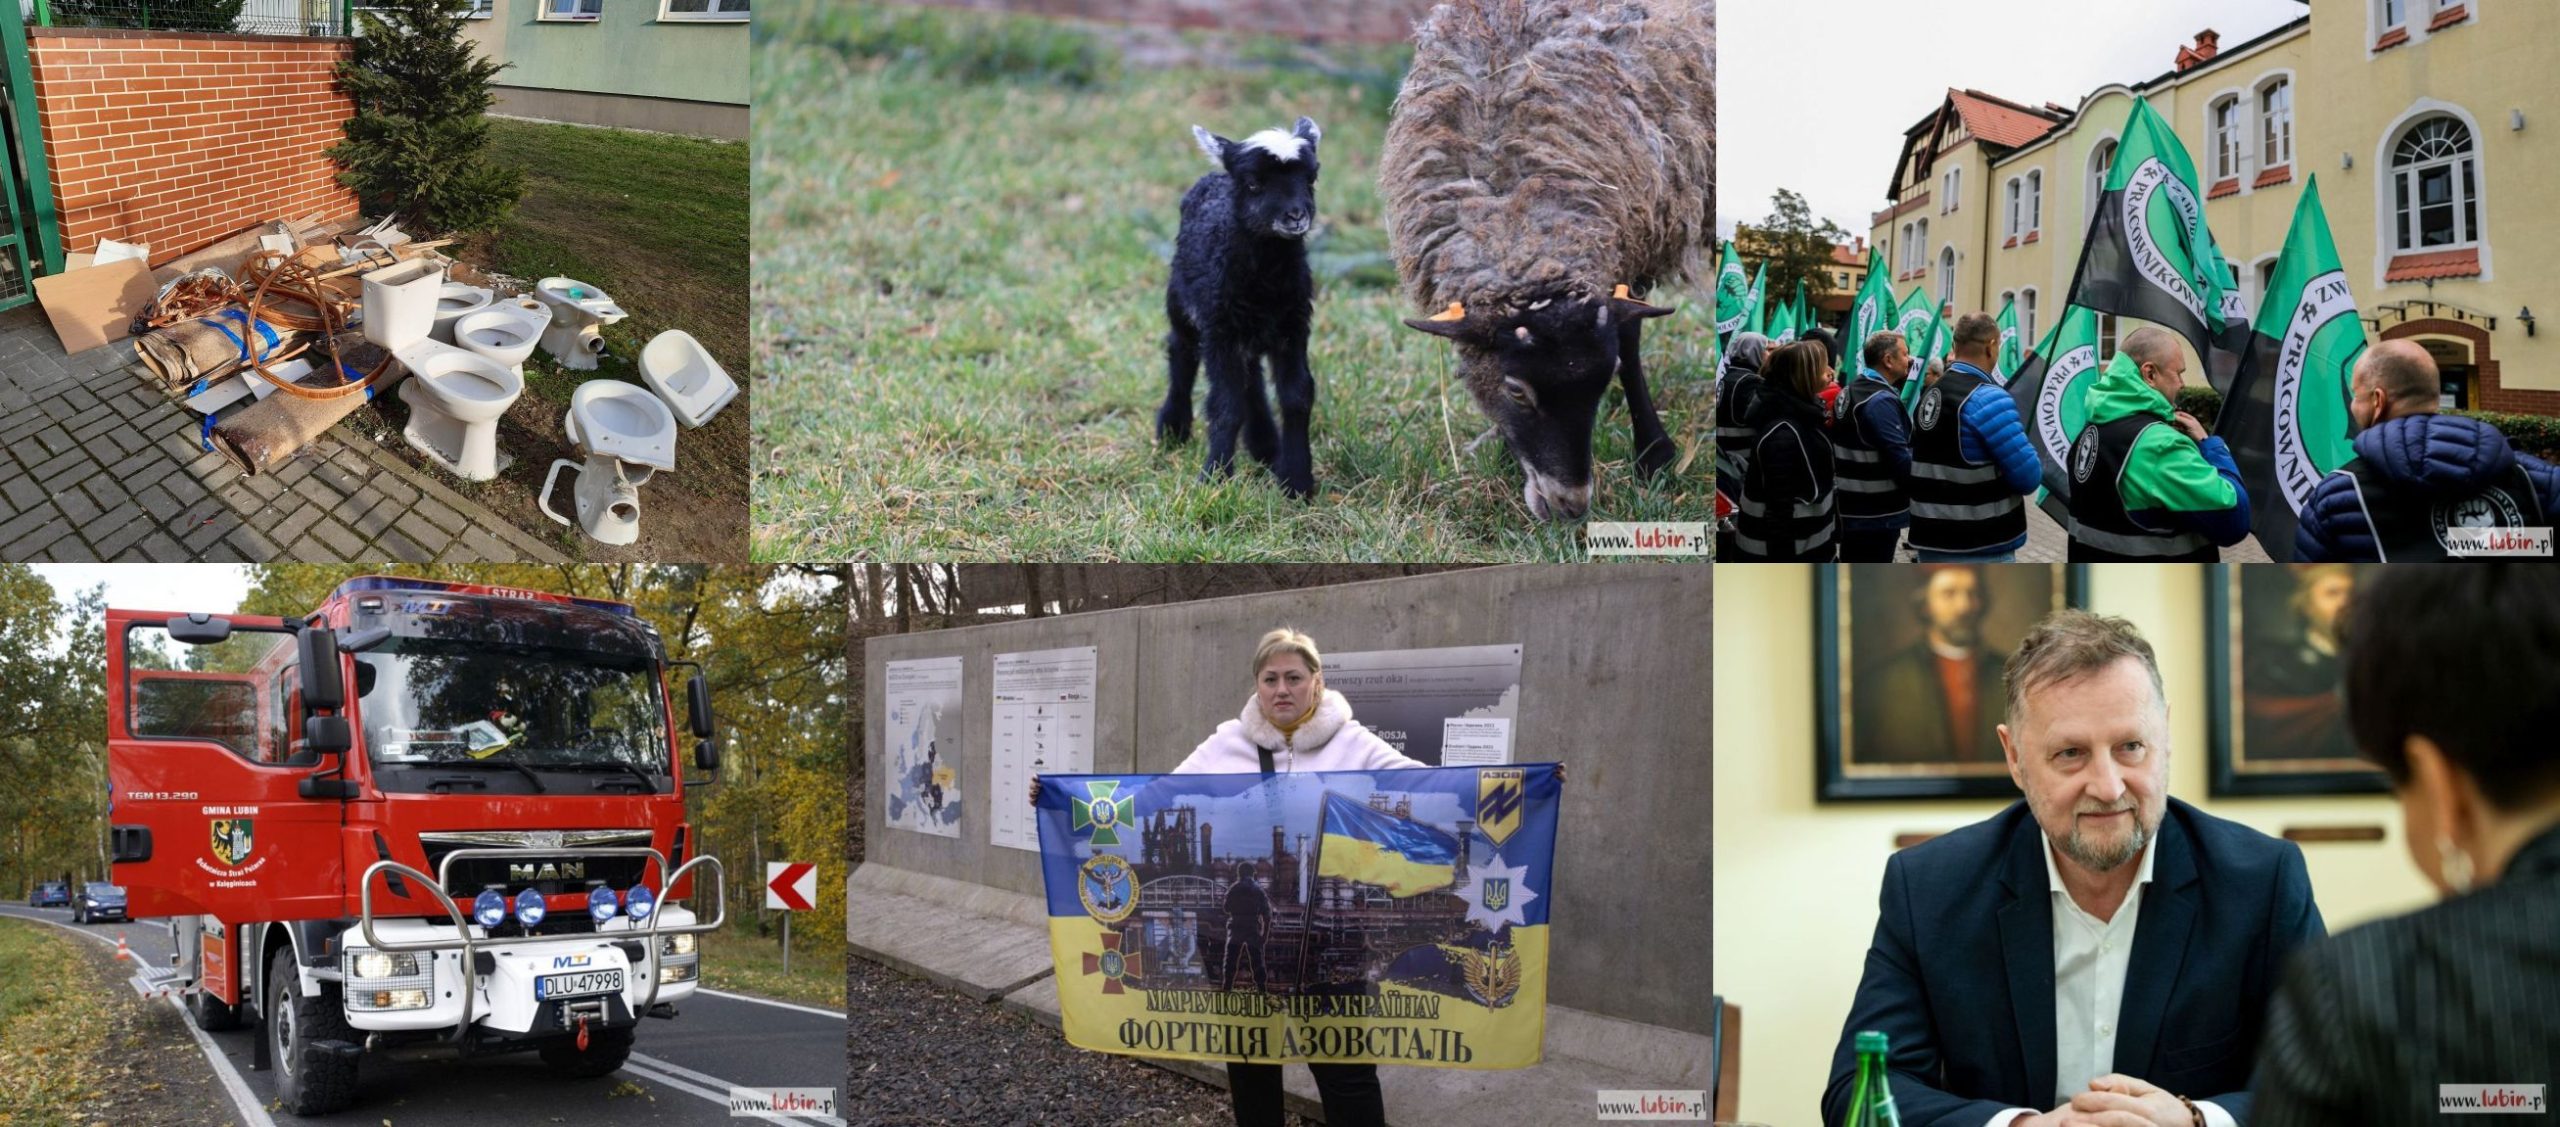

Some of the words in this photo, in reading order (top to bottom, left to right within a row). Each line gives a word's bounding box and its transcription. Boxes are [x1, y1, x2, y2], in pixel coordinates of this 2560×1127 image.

[2041, 364, 2071, 460] PRACOWNIK
[1378, 730, 1407, 740] ROSJA
[1482, 771, 1521, 779] АЗОВ
[127, 791, 154, 800] TGM
[155, 791, 198, 800] 13.290
[202, 806, 231, 815] GMINA
[233, 806, 259, 815] LUBIN
[510, 862, 585, 881] MAN
[545, 976, 574, 996] DLU
[578, 971, 621, 992] 47998
[1289, 994, 1324, 1023] ЦЕ
[1329, 990, 1440, 1019] УКРАЇНА!
[1119, 1018, 1271, 1064] ФОРТЕЦЯ
[1279, 1026, 1473, 1063] АЗОВСТАЛЬ
